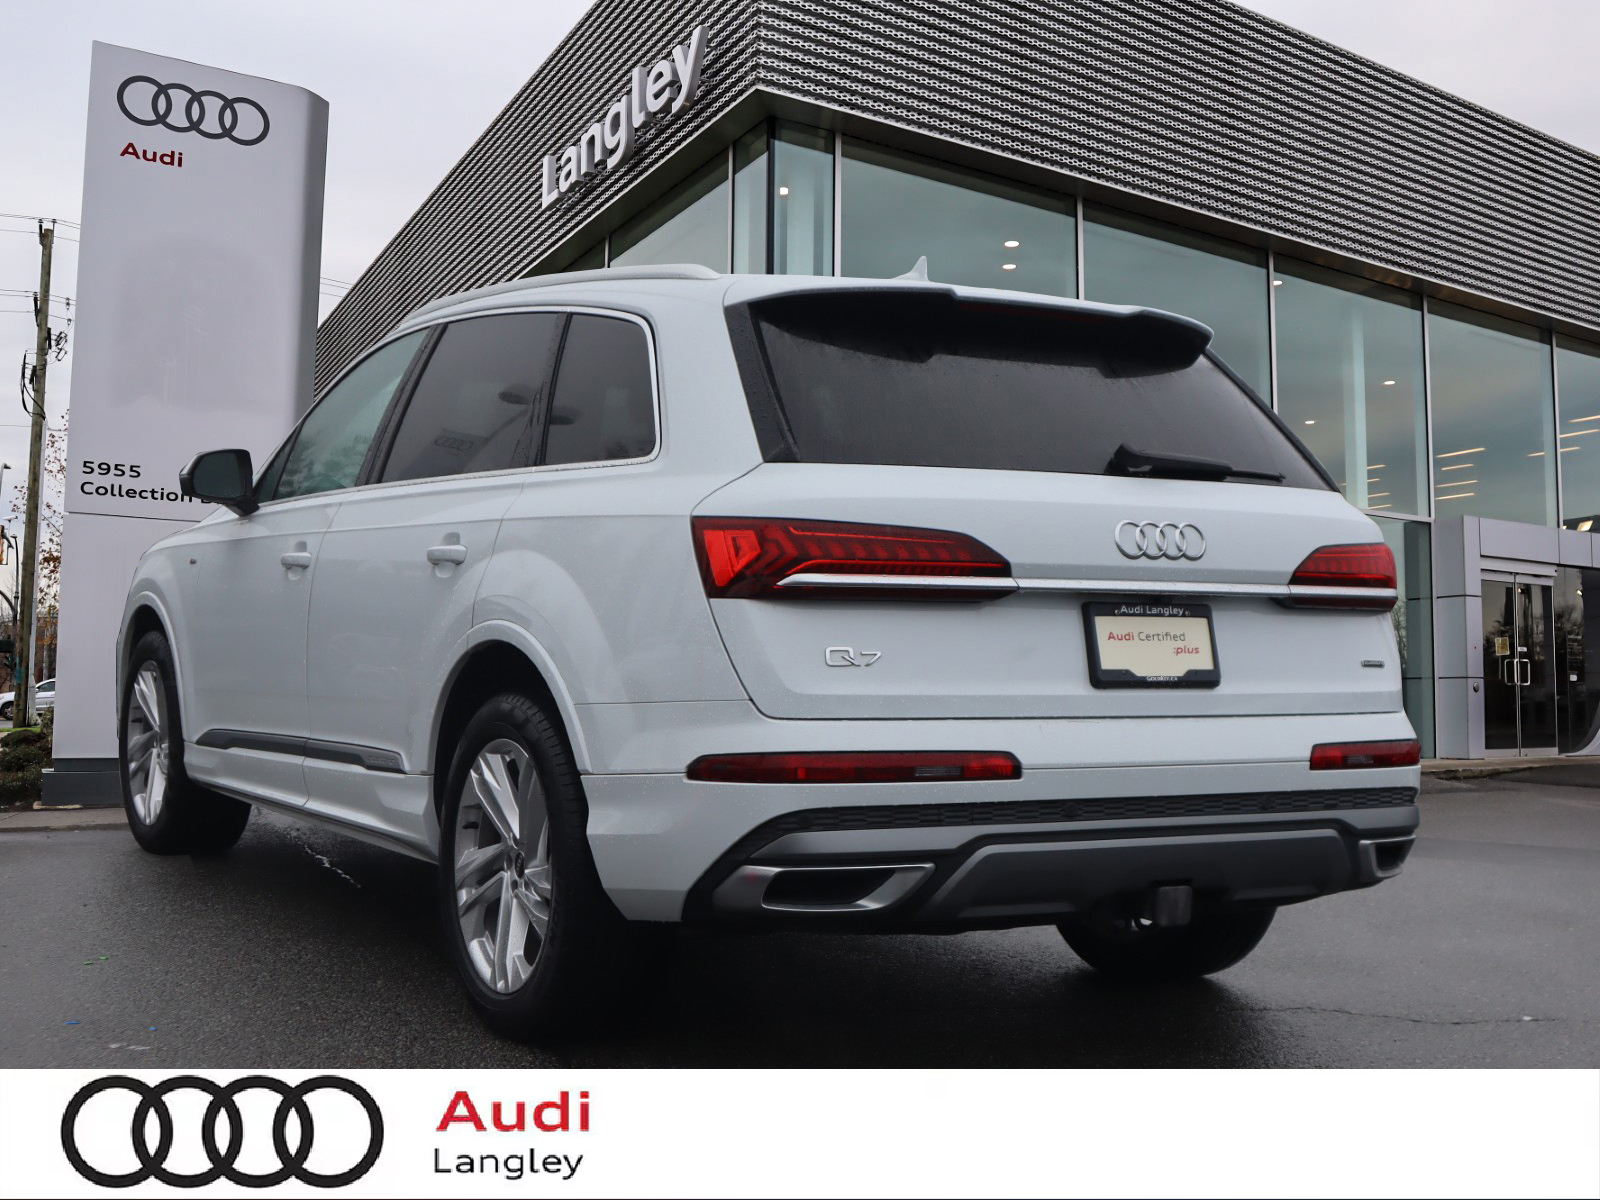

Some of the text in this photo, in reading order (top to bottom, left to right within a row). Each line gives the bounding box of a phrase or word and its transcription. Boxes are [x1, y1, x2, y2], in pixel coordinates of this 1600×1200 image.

[541, 24, 710, 209] Langley
[120, 142, 183, 168] Audi
[82, 460, 141, 478] 5955
[1120, 604, 1184, 616] Audi Langley
[1107, 631, 1186, 642] Audi Certified
[825, 646, 882, 667] Q7
